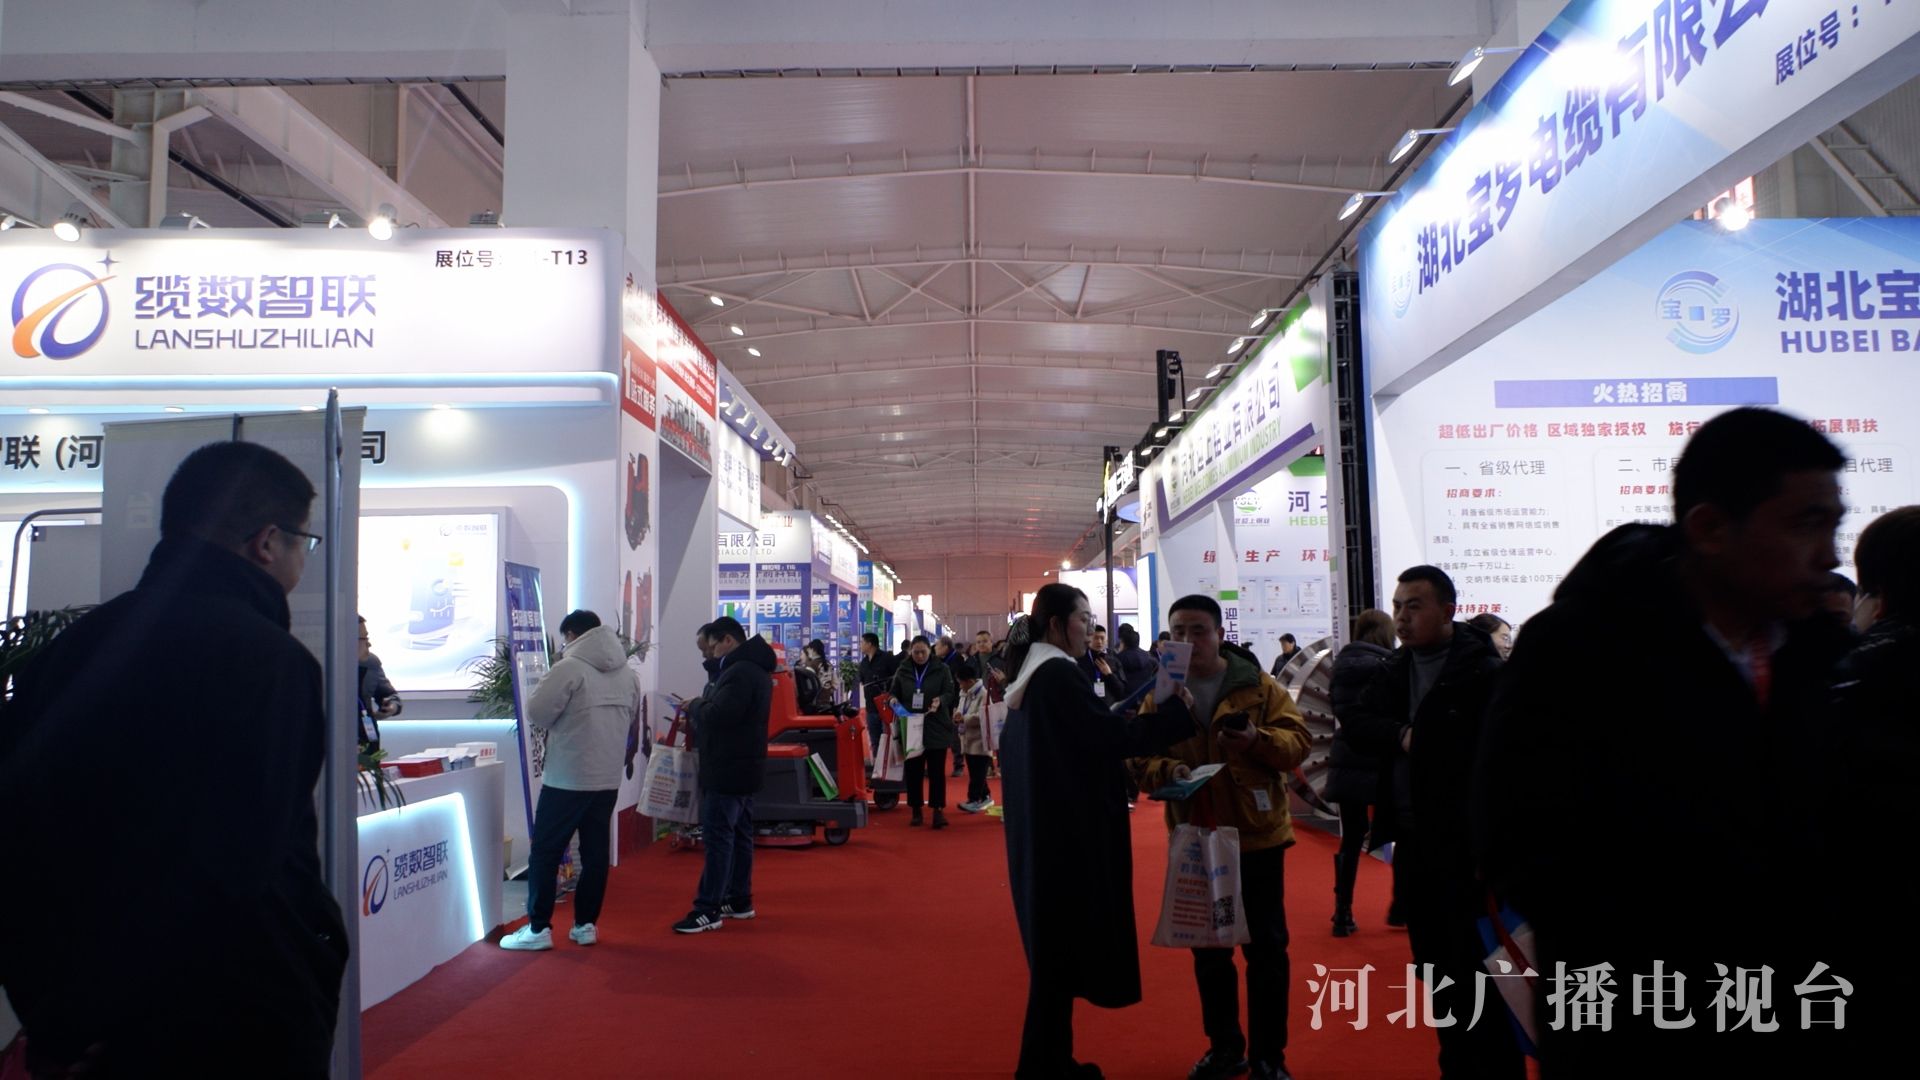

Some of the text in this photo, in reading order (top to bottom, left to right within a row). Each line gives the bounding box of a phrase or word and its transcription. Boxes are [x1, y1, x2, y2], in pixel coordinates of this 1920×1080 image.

[1776, 3, 1860, 85] 展位号：
[135, 274, 377, 319] 缆数智联
[135, 329, 375, 350] LANSHUZHILIAN
[1780, 329, 1880, 354] HUBEI
[1592, 381, 1688, 404] 火热招商
[1438, 422, 1539, 440] 超低出厂价格
[1547, 420, 1648, 438] 区域独家授权
[1810, 418, 1879, 434] 拓展帮扶
[0, 434, 103, 471] 联（河
[1846, 457, 1894, 473] 目代理
[1289, 515, 1329, 526] HEBE
[1203, 549, 1280, 563] 绿生产
[394, 839, 449, 882] 缆数智联
